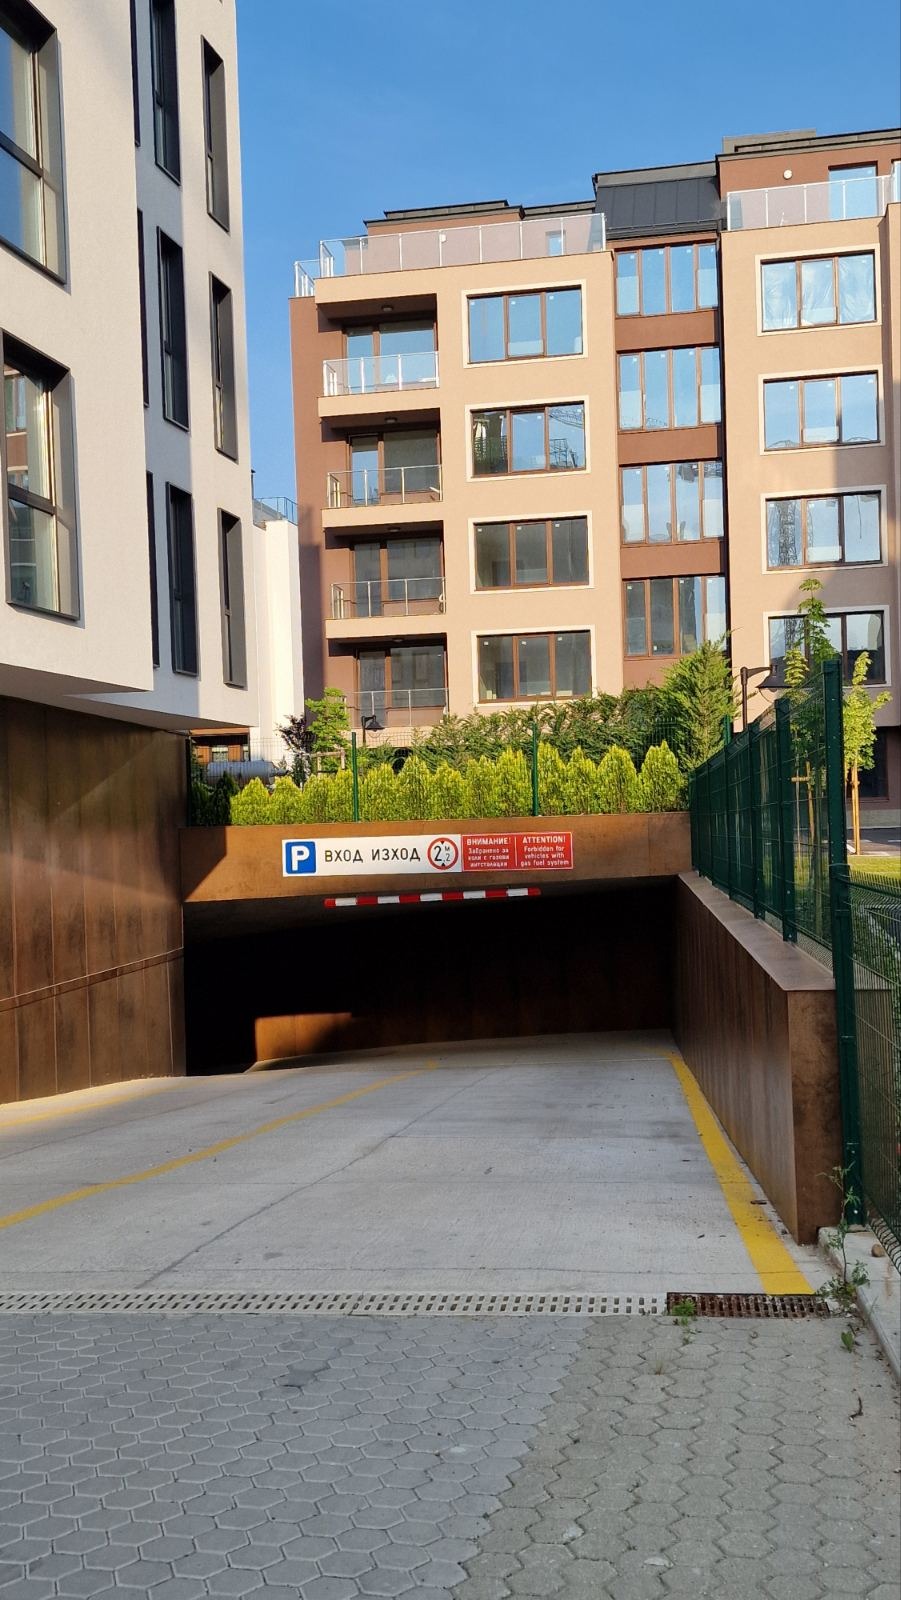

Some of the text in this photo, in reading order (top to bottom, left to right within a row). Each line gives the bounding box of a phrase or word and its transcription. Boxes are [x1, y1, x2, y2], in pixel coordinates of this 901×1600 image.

[466, 837, 511, 846] ВНИМАНИЕ!
[522, 835, 566, 844] ATTENTION!
[291, 845, 310, 872] P
[324, 848, 421, 863] ВХОД ИЗХОД
[520, 860, 531, 868] gas
[547, 858, 570, 867] system
